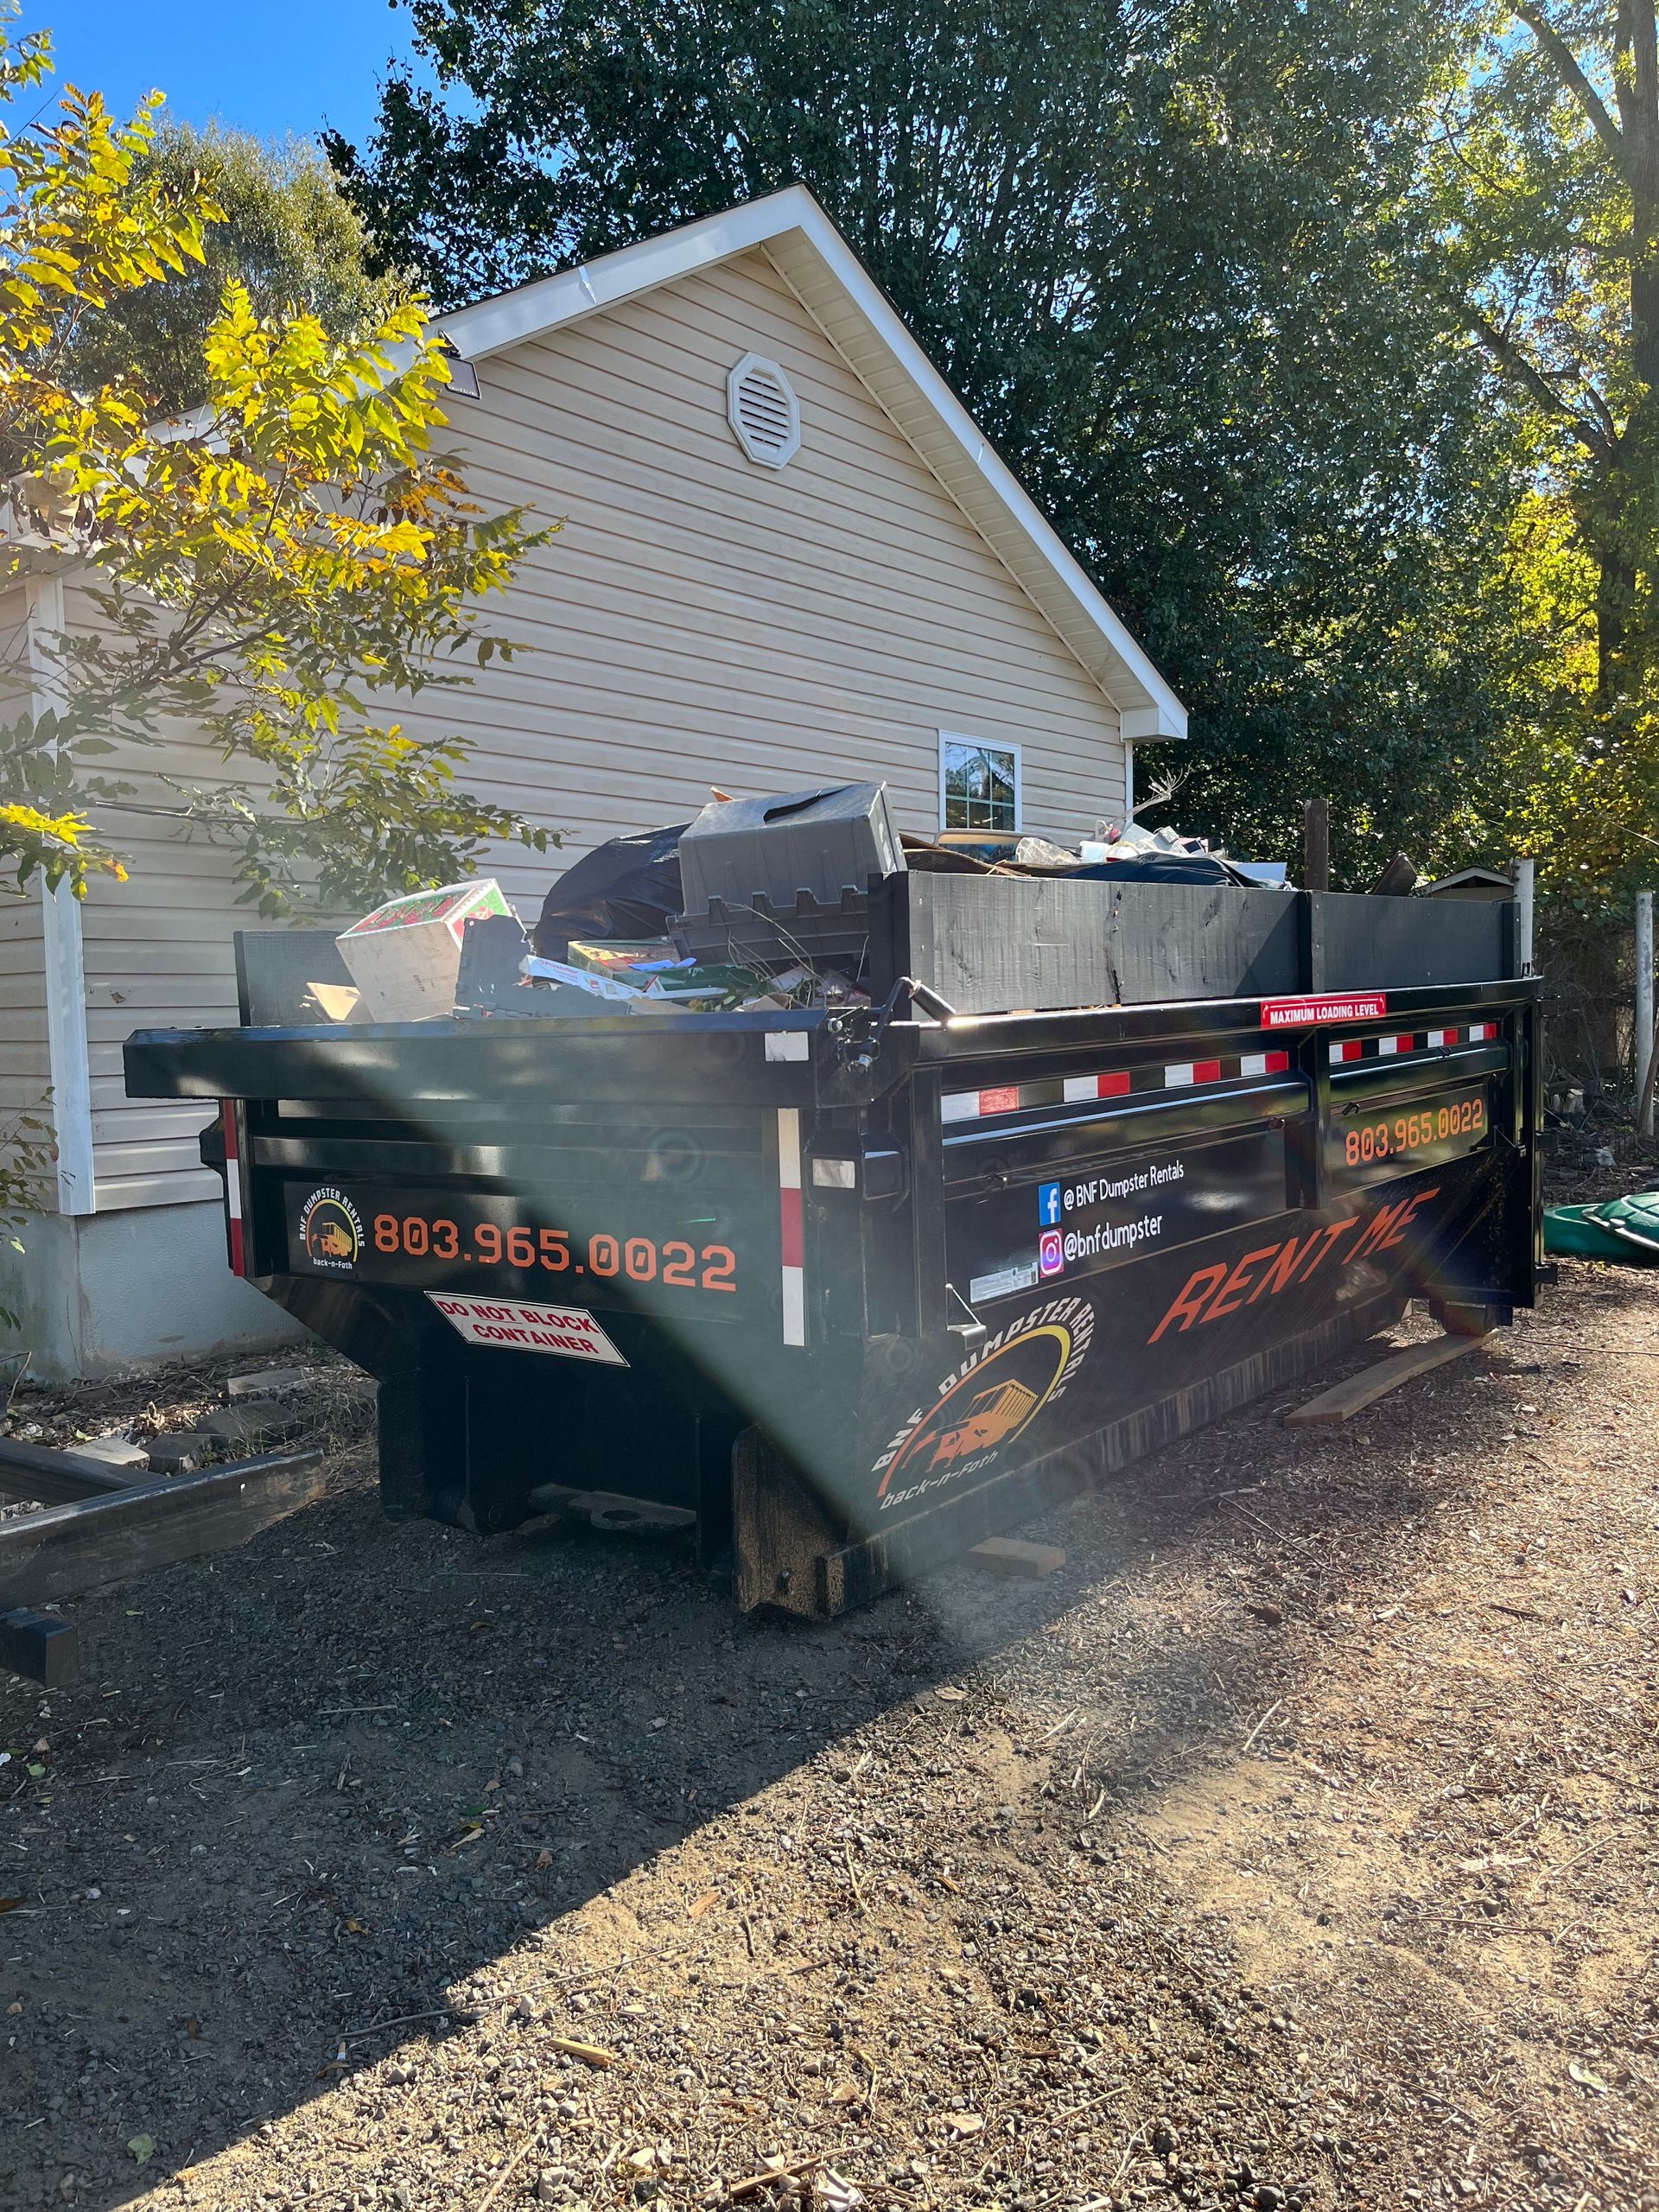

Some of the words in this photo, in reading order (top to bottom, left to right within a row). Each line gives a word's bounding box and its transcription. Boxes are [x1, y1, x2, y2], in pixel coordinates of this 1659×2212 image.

[1270, 1007, 1314, 1025] MAXIMUM
[1317, 1005, 1353, 1020] LOADING
[1355, 1003, 1378, 1016] LEVEL
[1345, 1097, 1484, 1166] 803.965.0022
[1077, 1182, 1097, 1207] BNF
[1100, 1171, 1148, 1200] Dumpster
[1150, 1160, 1185, 1185] Rentals
[303, 1187, 340, 1214] DUMPSTER
[341, 1196, 365, 1247] RENTALS
[1064, 1214, 1163, 1262] @bnfdumpster
[313, 1257, 353, 1269] back-n-Foth
[373, 1213, 736, 1292] 803.965.0022
[1147, 1215, 1361, 1344] RENT
[1341, 1187, 1440, 1265] ME
[436, 1300, 470, 1317] DO
[469, 1304, 522, 1323] NOT
[518, 1309, 601, 1334] BLOCK
[473, 1324, 600, 1354] CONTAINER
[871, 1408, 923, 1471] BNF
[938, 1297, 1082, 1395] DUMPSTER
[1046, 1302, 1095, 1402] RENTALS
[879, 1450, 999, 1510] back-n-Foth
